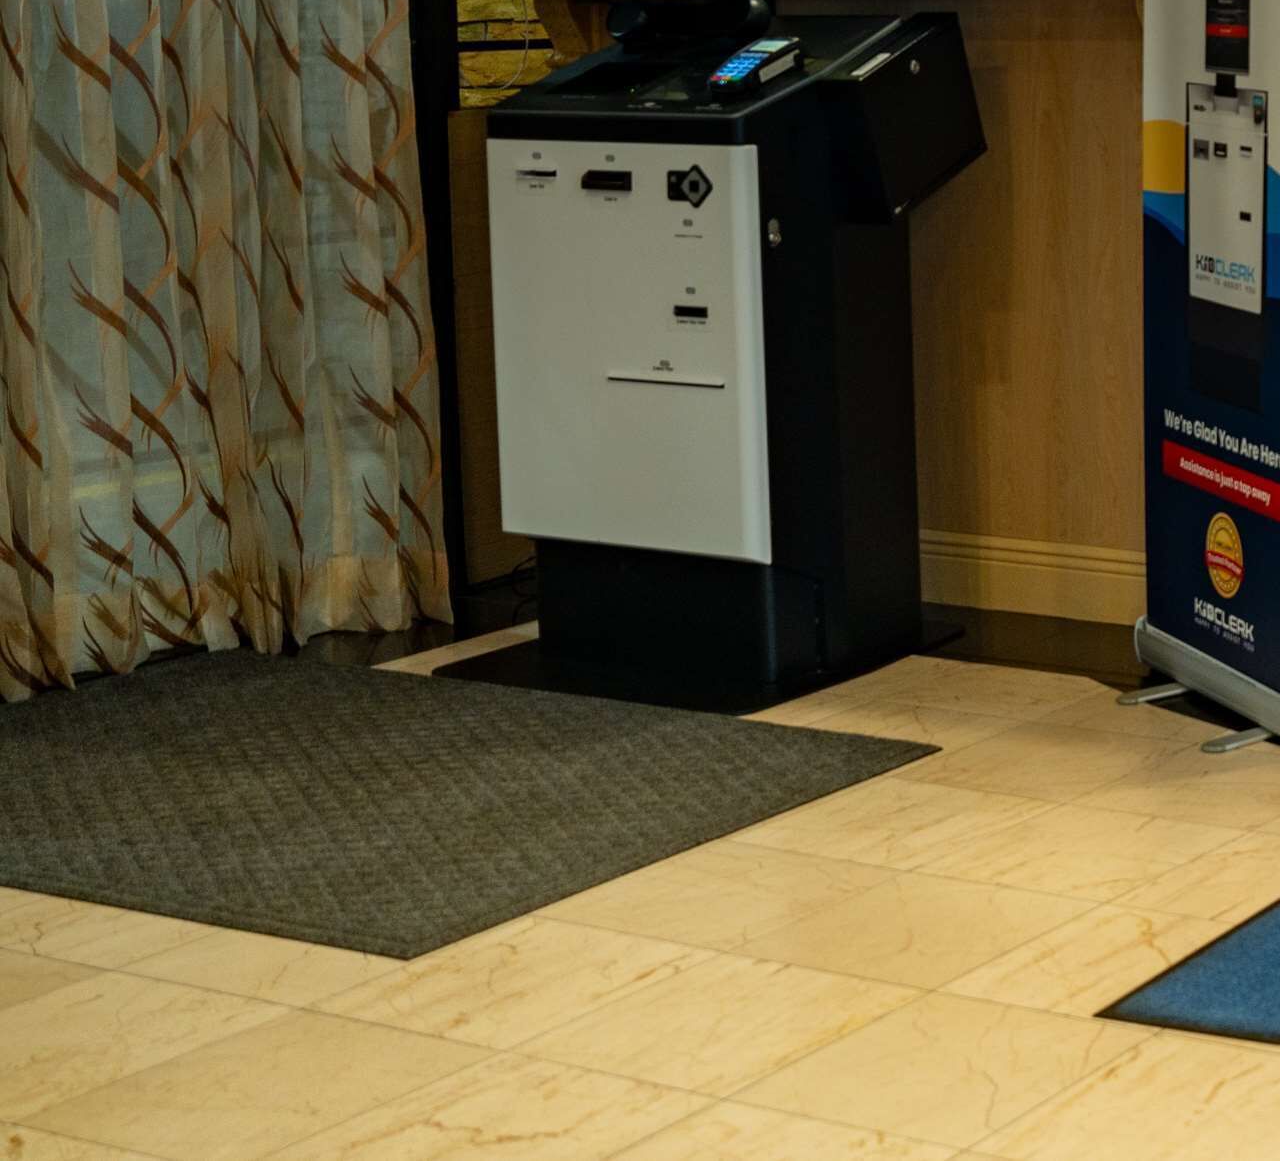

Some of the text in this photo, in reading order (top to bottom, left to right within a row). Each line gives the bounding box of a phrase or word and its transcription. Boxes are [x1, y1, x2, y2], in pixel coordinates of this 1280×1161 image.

[1164, 408, 1192, 435] We're
[1194, 420, 1218, 444] Glad
[1219, 429, 1239, 453] You
[1240, 438, 1259, 461] Are
[1180, 457, 1213, 479] Assistance
[1220, 471, 1233, 489] just
[1251, 488, 1271, 506] away
